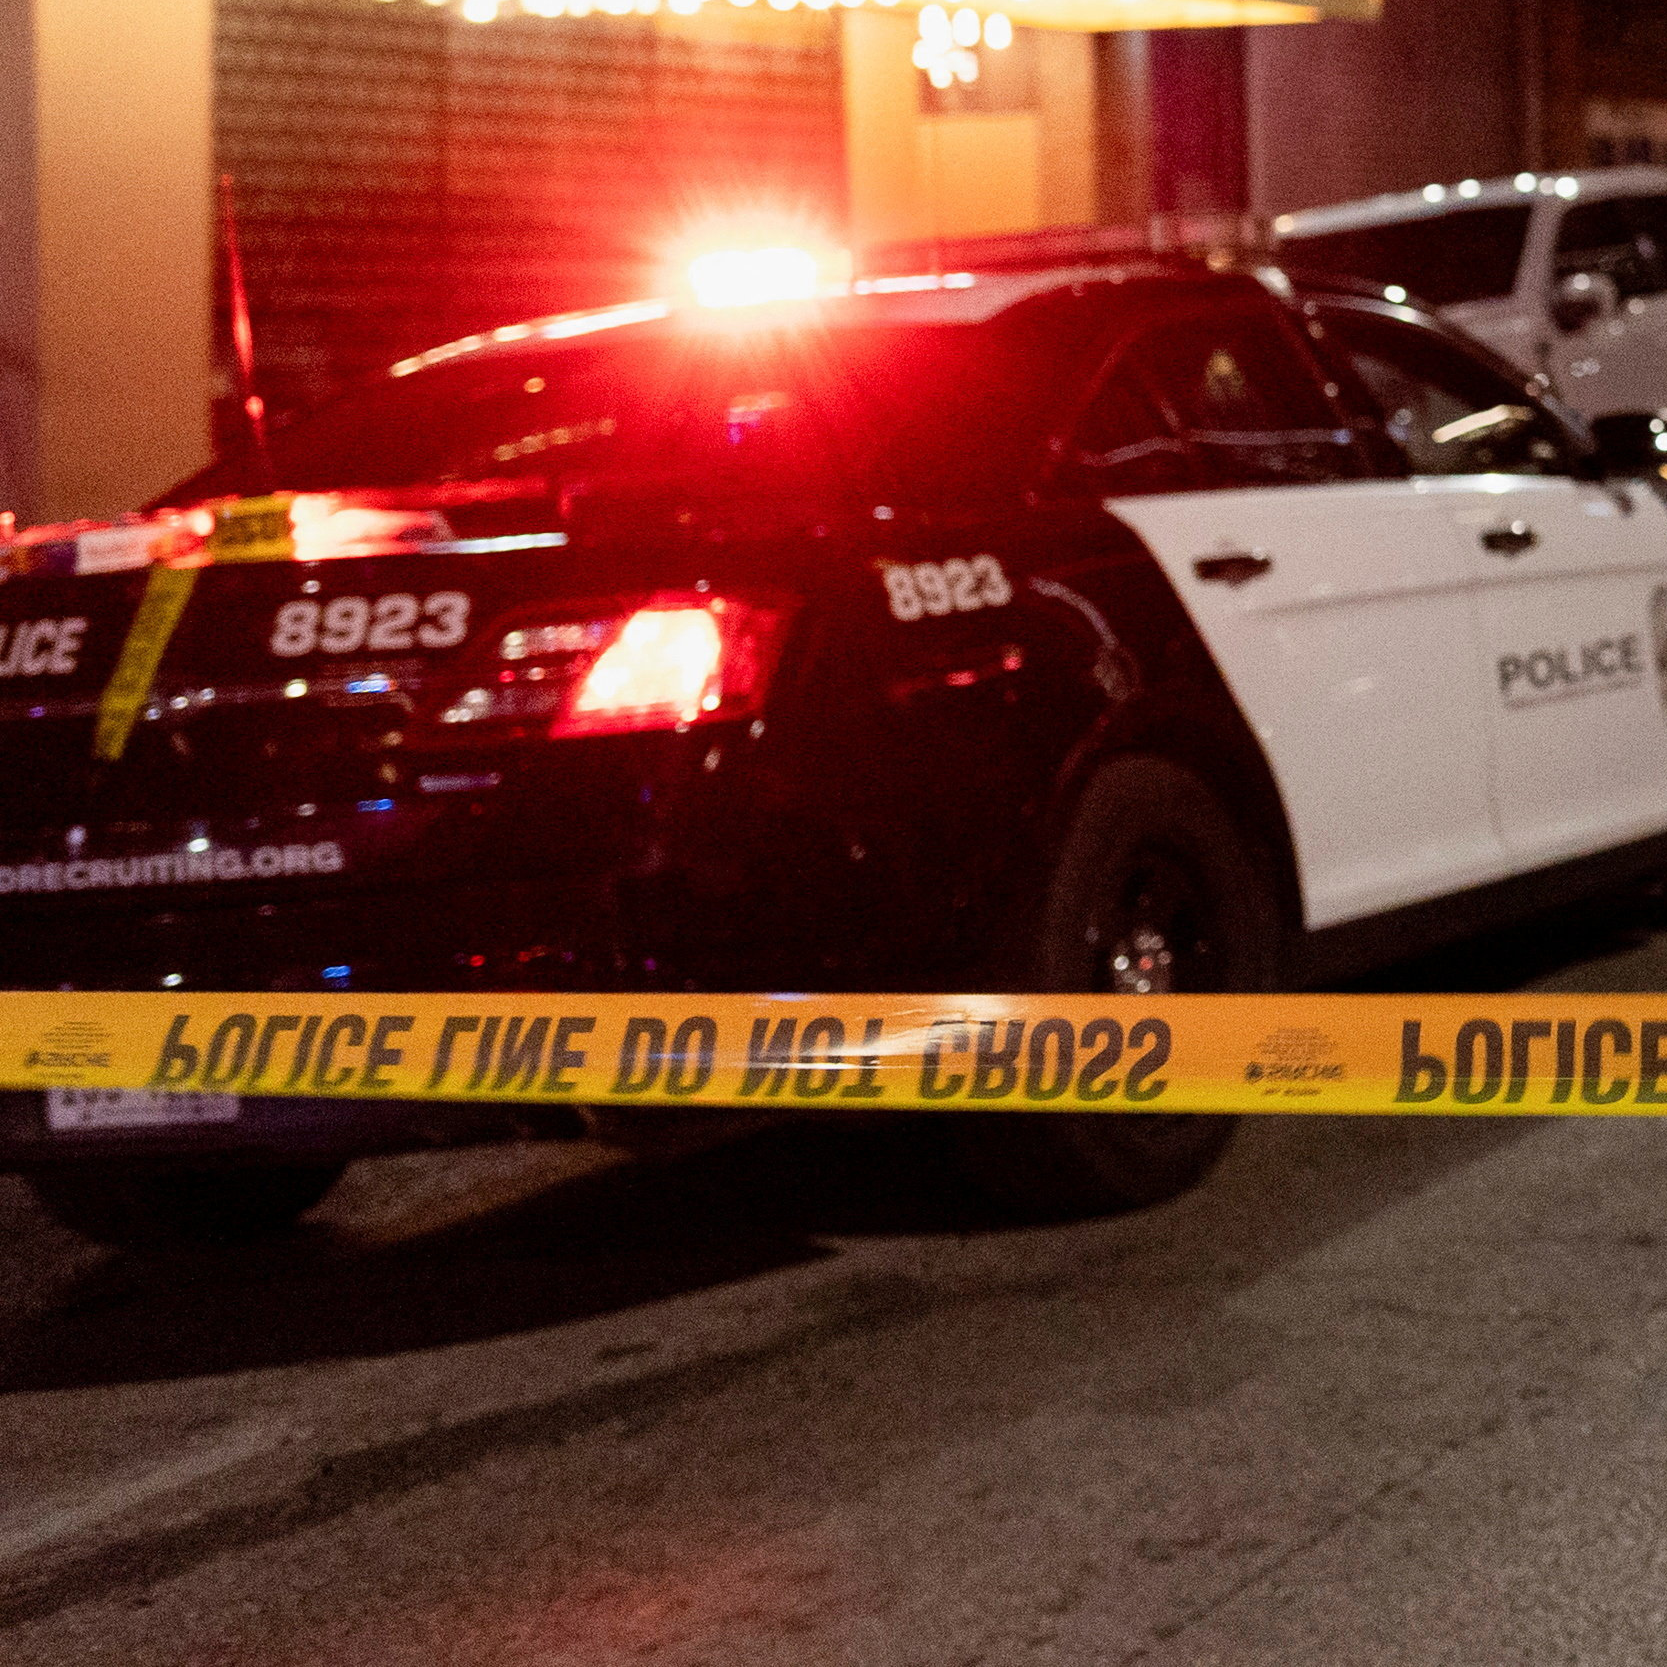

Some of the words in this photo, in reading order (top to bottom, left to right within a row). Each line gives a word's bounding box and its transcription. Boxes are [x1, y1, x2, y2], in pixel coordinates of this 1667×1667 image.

[882, 554, 1013, 621] 8923
[270, 591, 470, 657] 8923
[1498, 635, 1643, 691] POLICE
